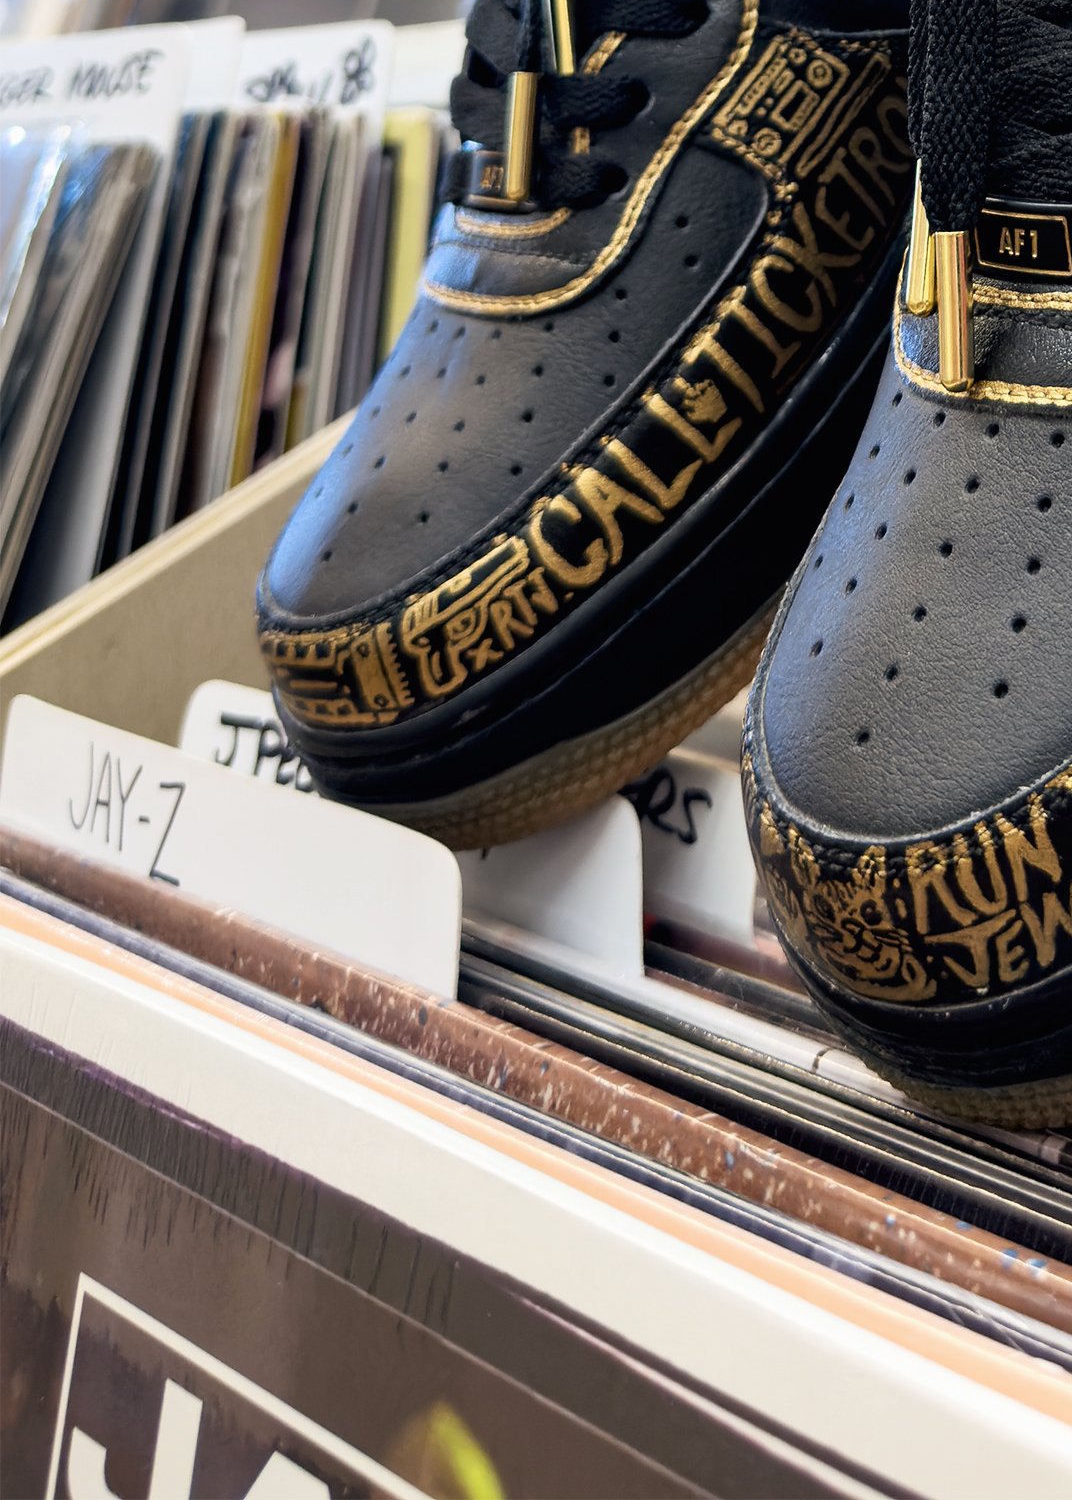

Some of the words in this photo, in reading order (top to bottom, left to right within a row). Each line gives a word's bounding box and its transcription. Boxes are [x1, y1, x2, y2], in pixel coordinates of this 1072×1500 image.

[682, 74, 916, 412] TICKETRO
[999, 227, 1039, 259] AF1
[66, 741, 186, 887] JAY-Z
[903, 790, 1061, 935] RUN
